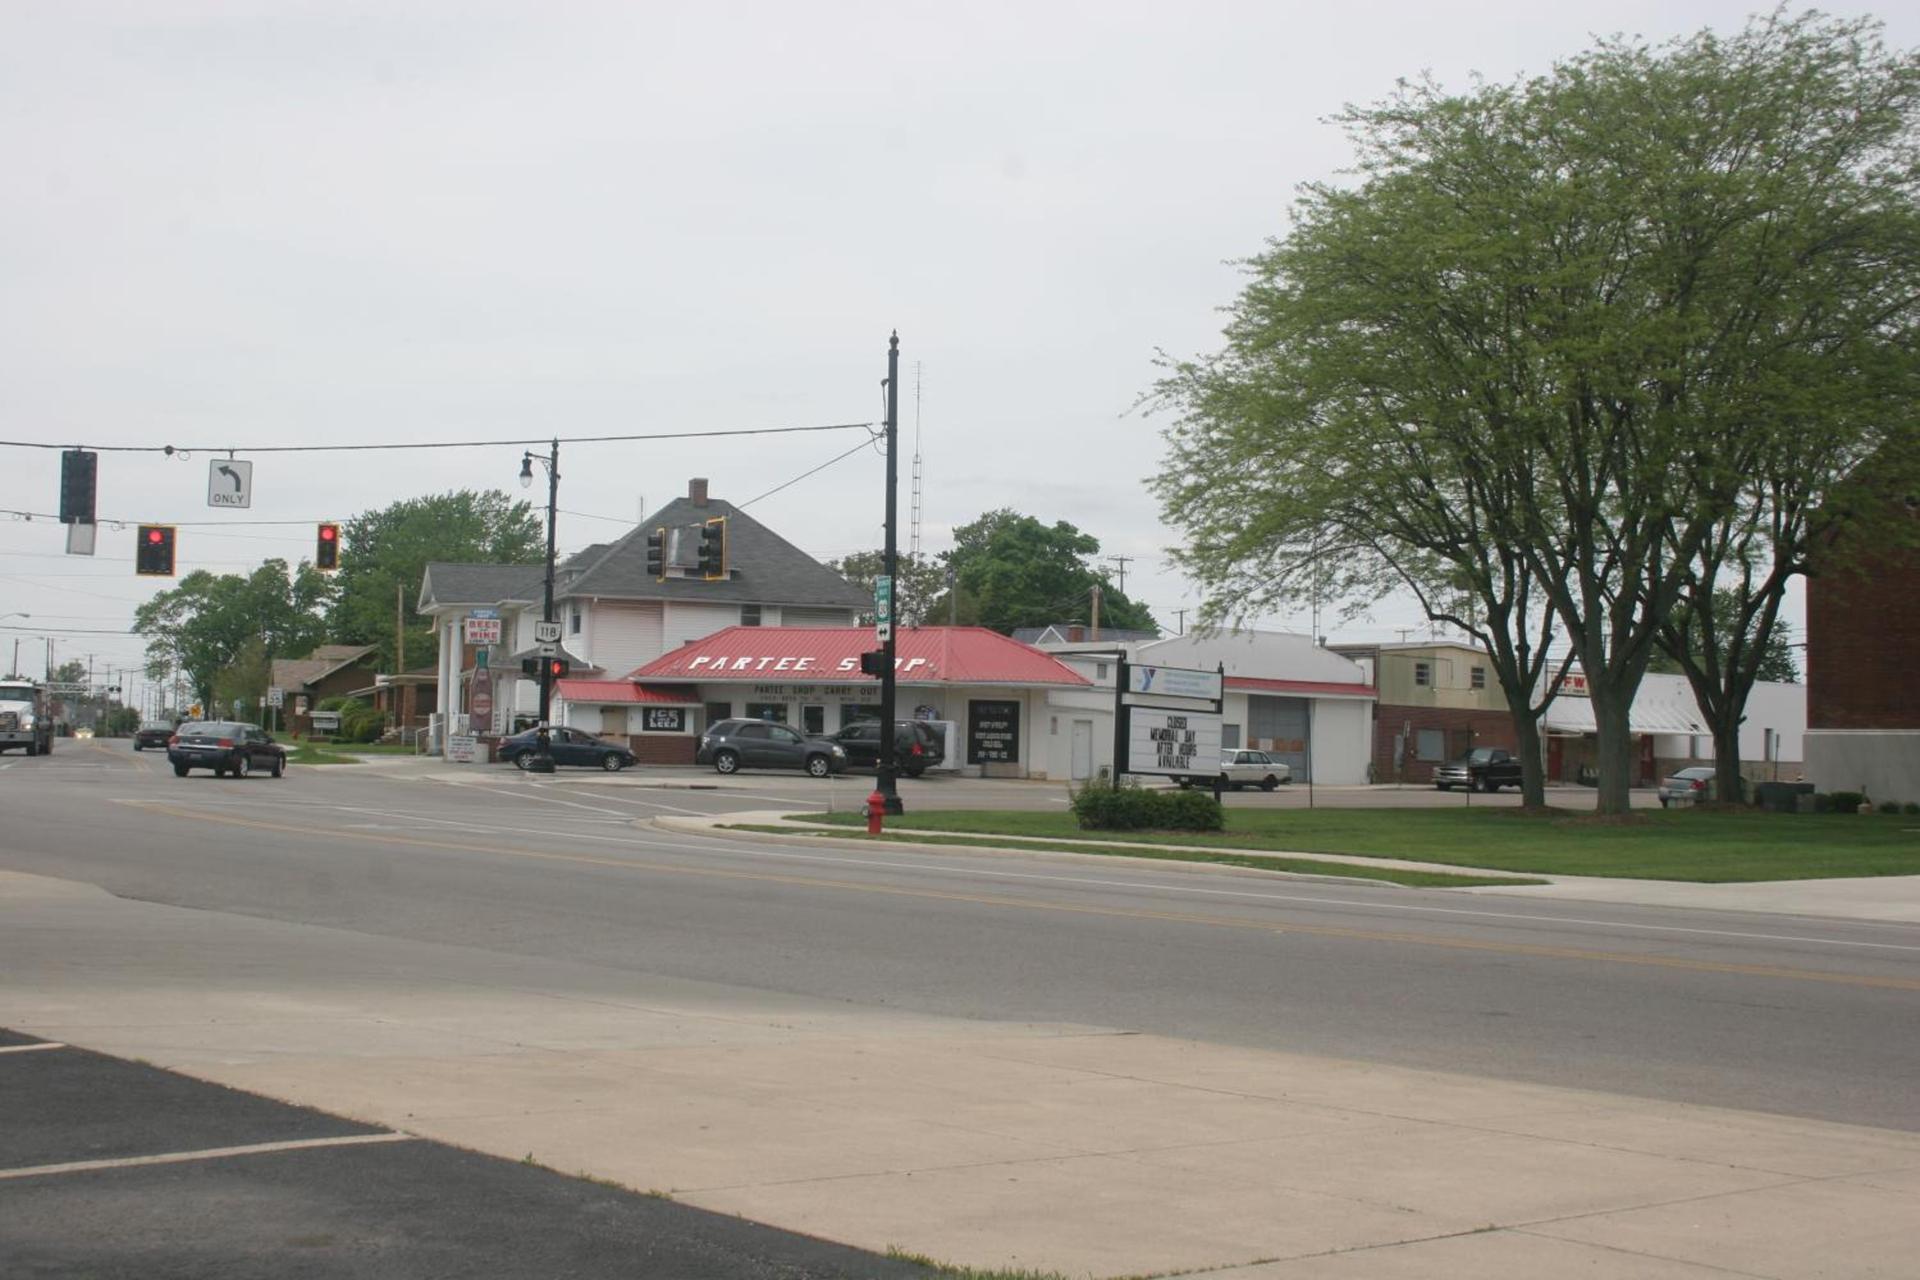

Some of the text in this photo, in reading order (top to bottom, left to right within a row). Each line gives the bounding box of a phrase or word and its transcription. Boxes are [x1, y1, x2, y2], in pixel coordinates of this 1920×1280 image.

[214, 494, 244, 504] ONLY
[469, 620, 499, 628] BEER
[470, 631, 498, 640] WINE
[541, 626, 556, 637] 118
[688, 657, 925, 672] PARTEE SP
[754, 685, 878, 695] PARTEE SHOP CARRY OUT
[1167, 716, 1187, 729] CLOSED
[1150, 728, 1196, 743] MEMORIAL DAY
[1157, 742, 1197, 757] AFTER HOURS
[1158, 756, 1190, 769] AVAILABLE
